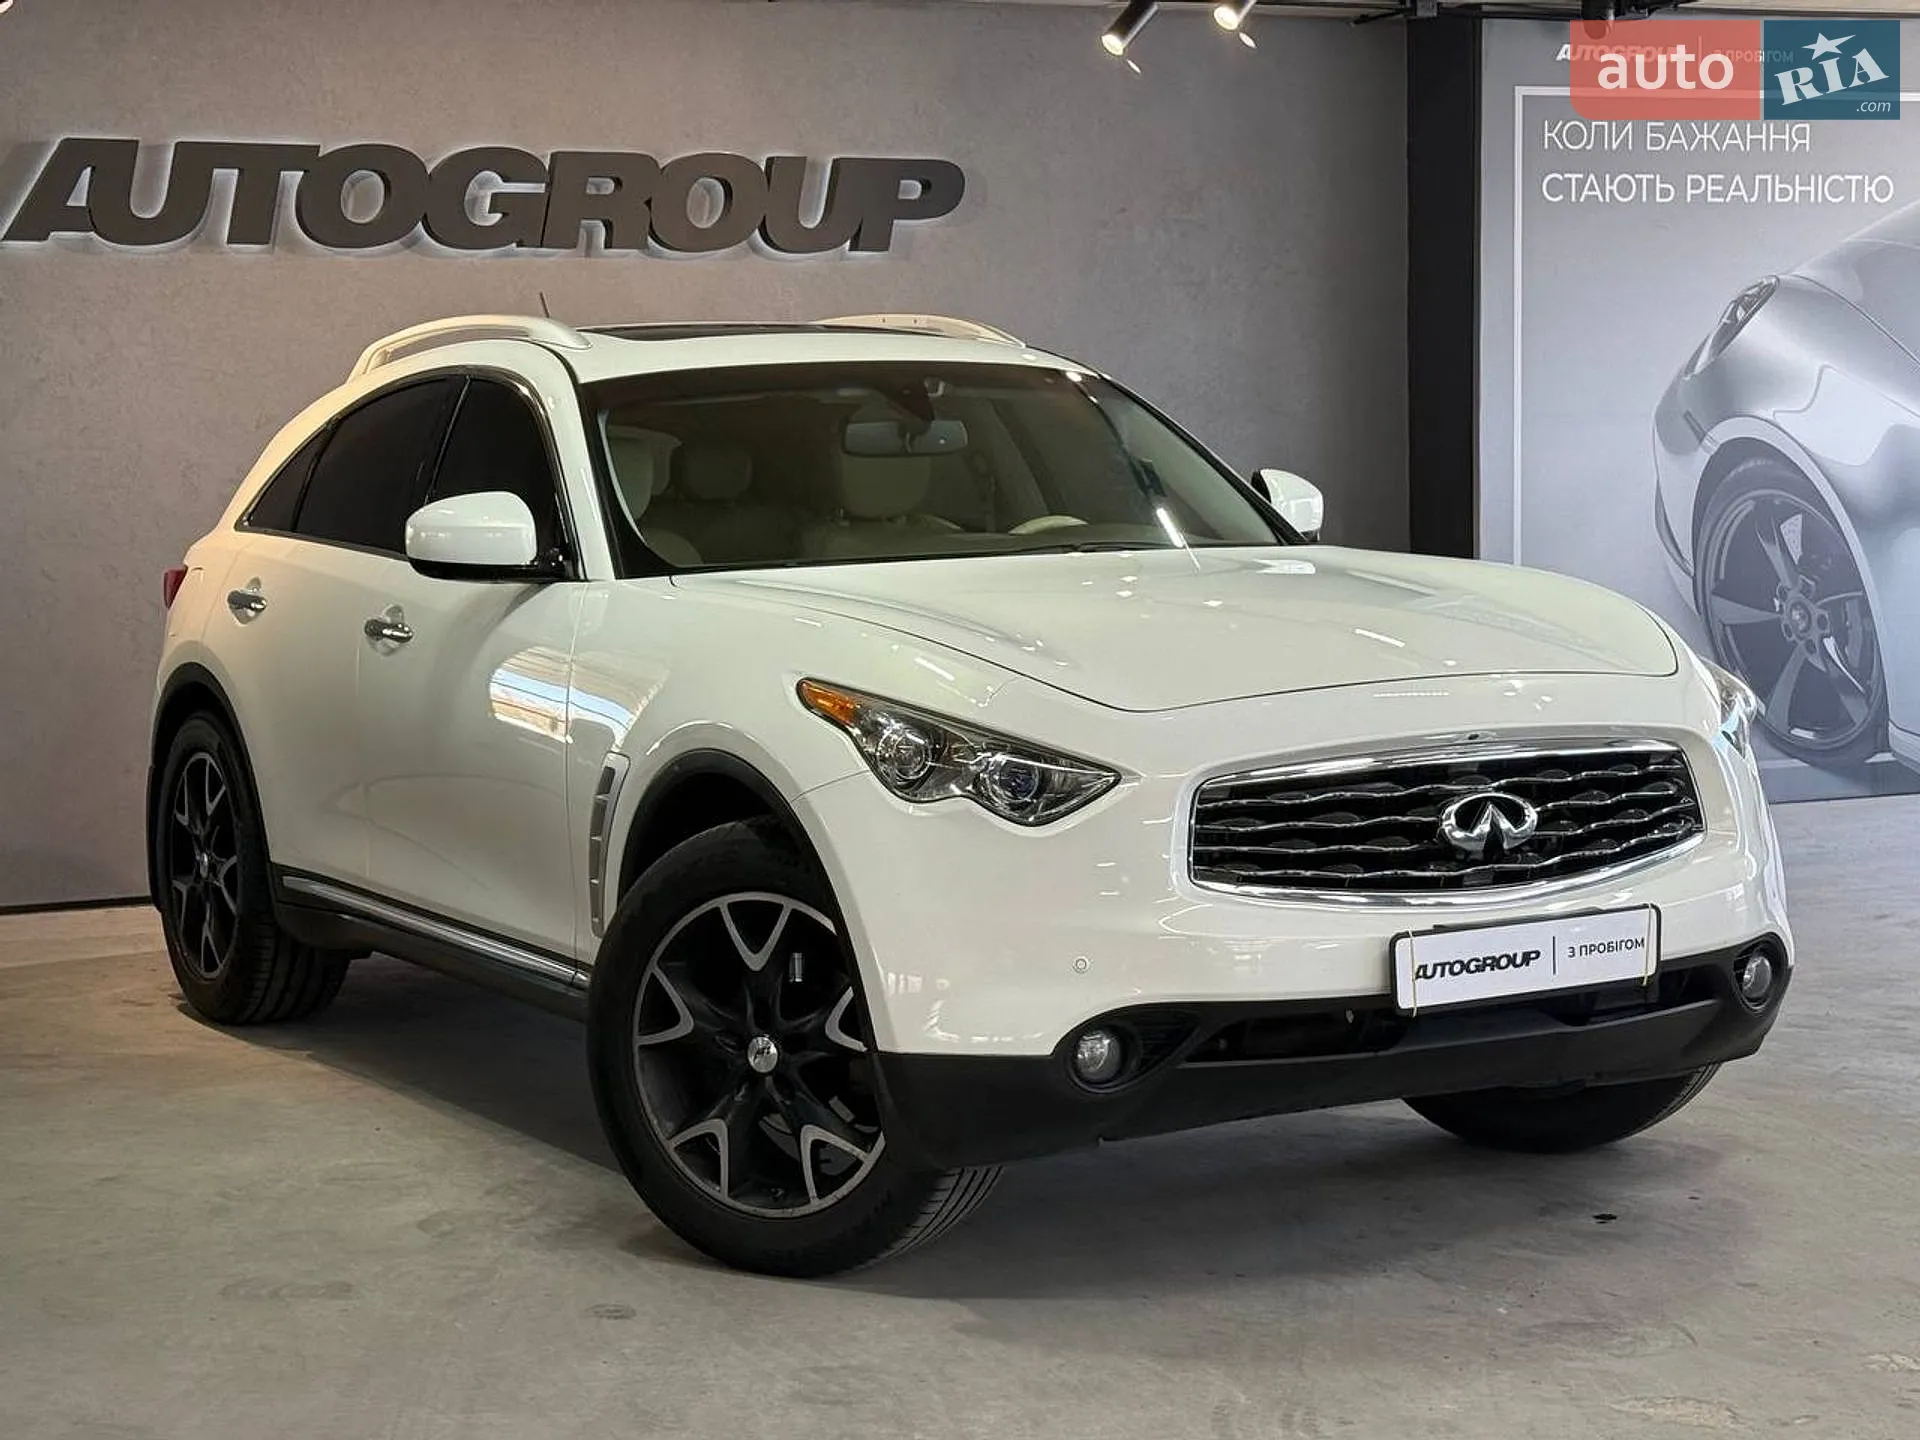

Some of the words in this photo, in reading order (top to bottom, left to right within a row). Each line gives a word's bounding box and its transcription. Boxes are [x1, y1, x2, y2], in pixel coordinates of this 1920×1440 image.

[1544, 121, 1632, 150] КОЛИ
[1646, 123, 1811, 151] БАЖАННЯ
[2, 138, 967, 254] AUTOGROUP
[1542, 174, 1675, 202] СТАЮТЬ
[1687, 174, 1895, 203] РЕАЛЬНІСТЮ
[1579, 937, 1645, 957] ПРОБІГОМ
[1415, 949, 1541, 980] AUTOGROUP
